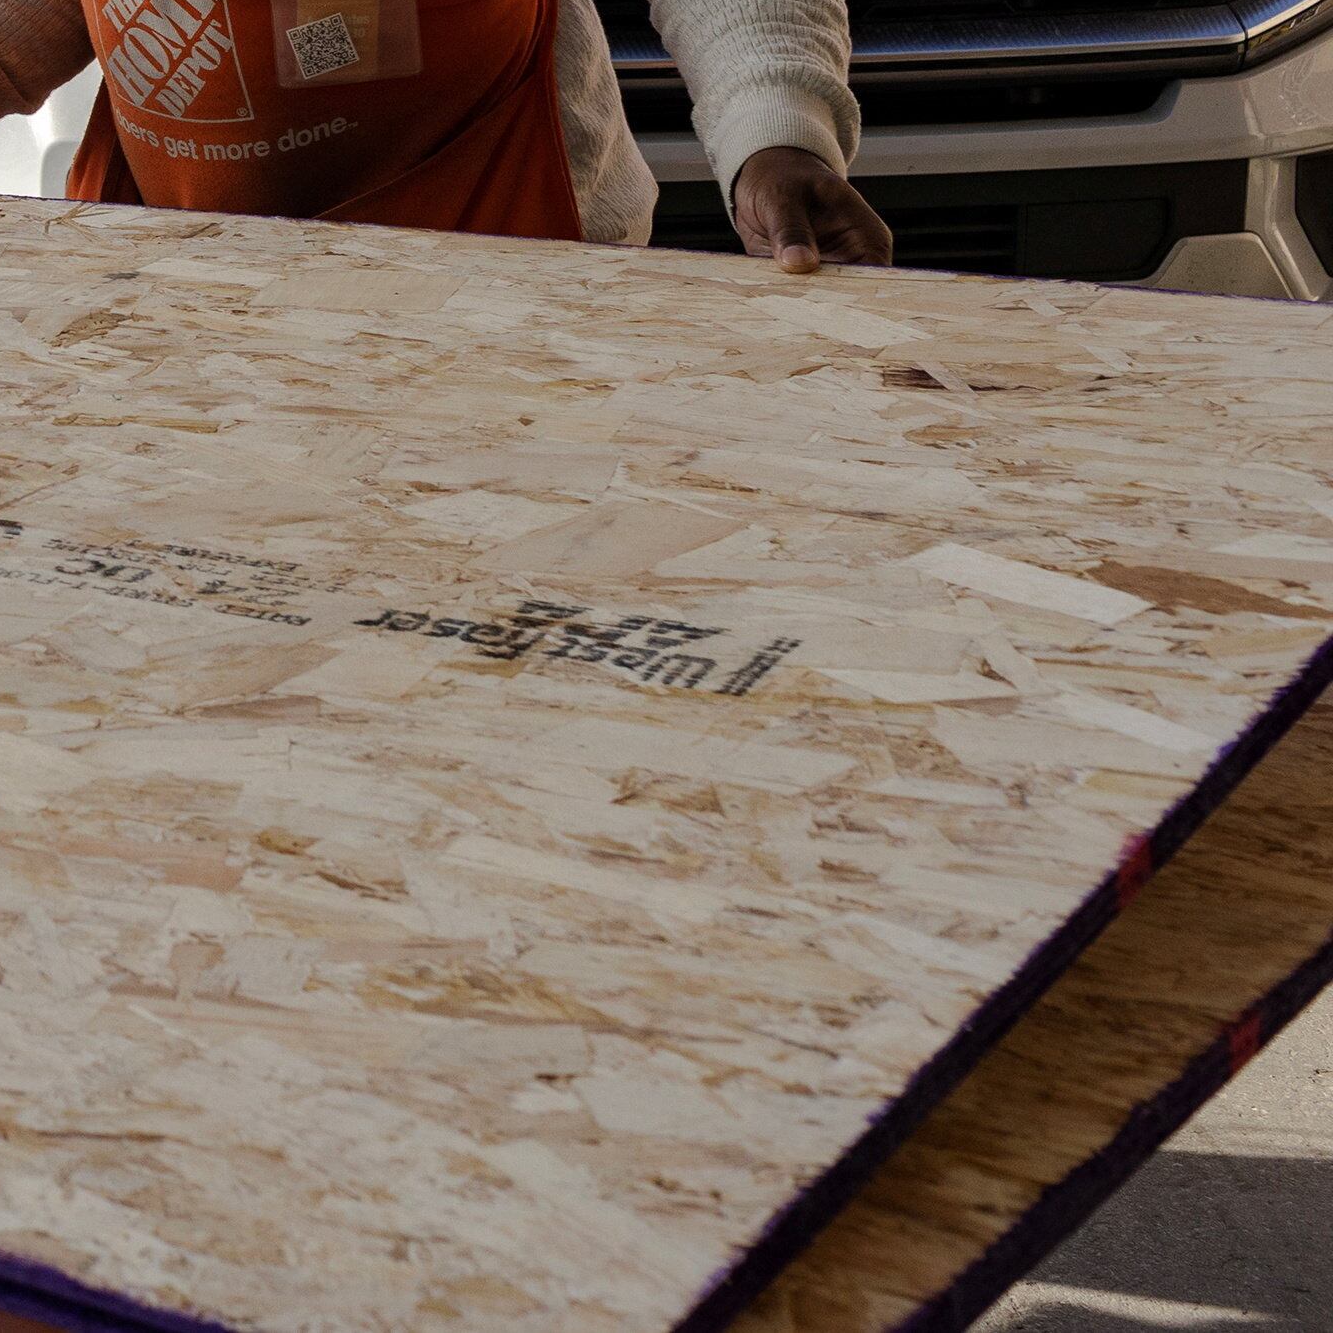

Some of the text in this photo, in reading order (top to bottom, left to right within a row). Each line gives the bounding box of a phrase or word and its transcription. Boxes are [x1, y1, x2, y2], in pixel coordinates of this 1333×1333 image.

[155, 19, 233, 117] DEPOT
[164, 134, 199, 161] get
[204, 139, 271, 161] more
